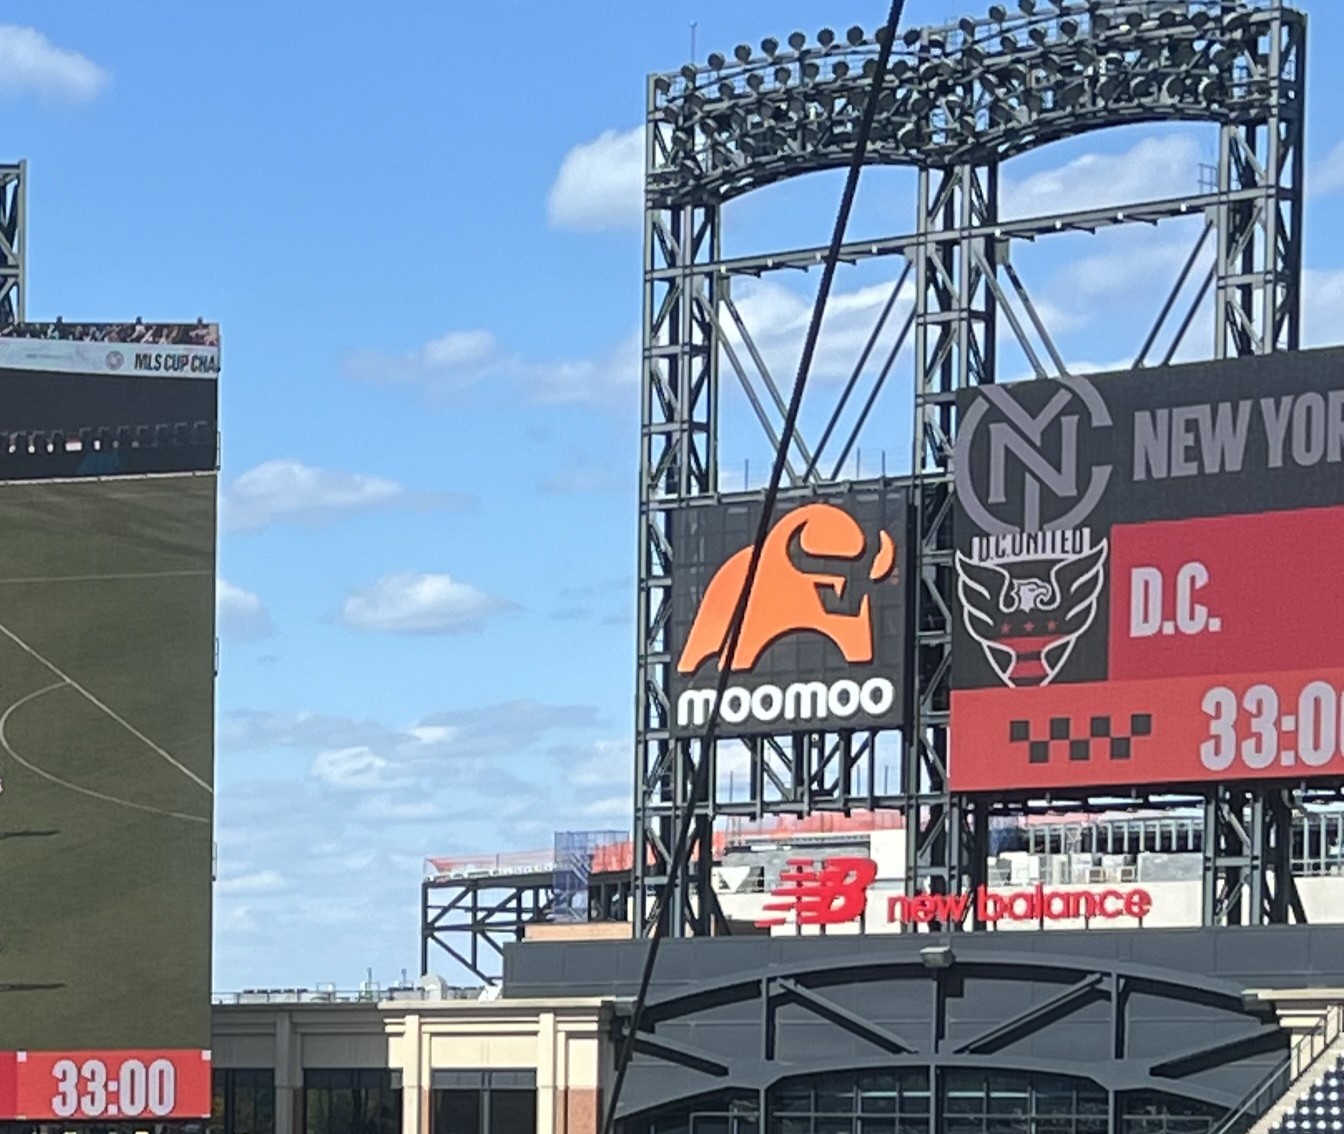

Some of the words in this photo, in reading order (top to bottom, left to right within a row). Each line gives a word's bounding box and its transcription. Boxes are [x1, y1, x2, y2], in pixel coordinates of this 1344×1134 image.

[134, 353, 162, 371] MLS
[164, 354, 188, 372] CUP
[1133, 398, 1253, 482] NEW
[1129, 561, 1222, 639] D.C.
[677, 677, 894, 728] moomoo
[1199, 681, 1344, 772] 33:0
[887, 887, 971, 924] new
[977, 882, 1153, 922] balance
[51, 1058, 176, 1118] 33:00
